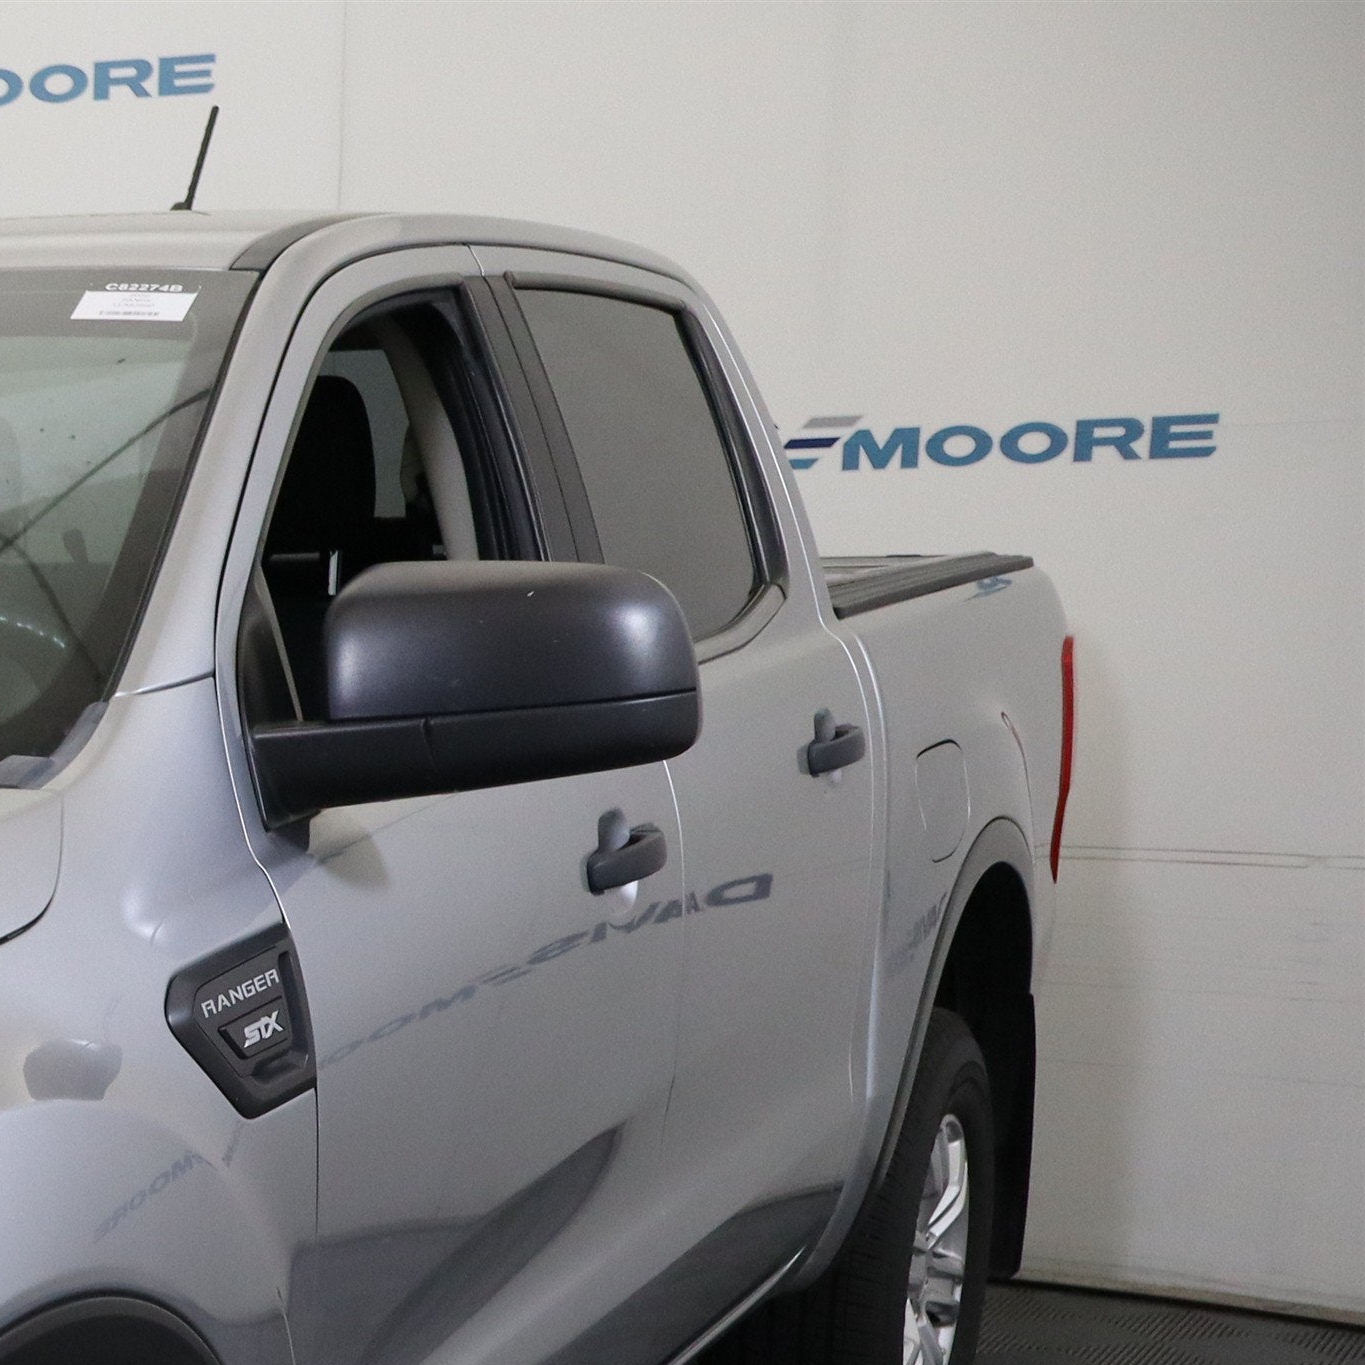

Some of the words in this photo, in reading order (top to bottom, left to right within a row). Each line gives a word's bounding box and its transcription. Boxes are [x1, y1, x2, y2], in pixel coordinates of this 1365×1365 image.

[841, 412, 1221, 472] MOORE
[200, 968, 280, 1019] RANGER
[243, 1009, 285, 1049] STX
